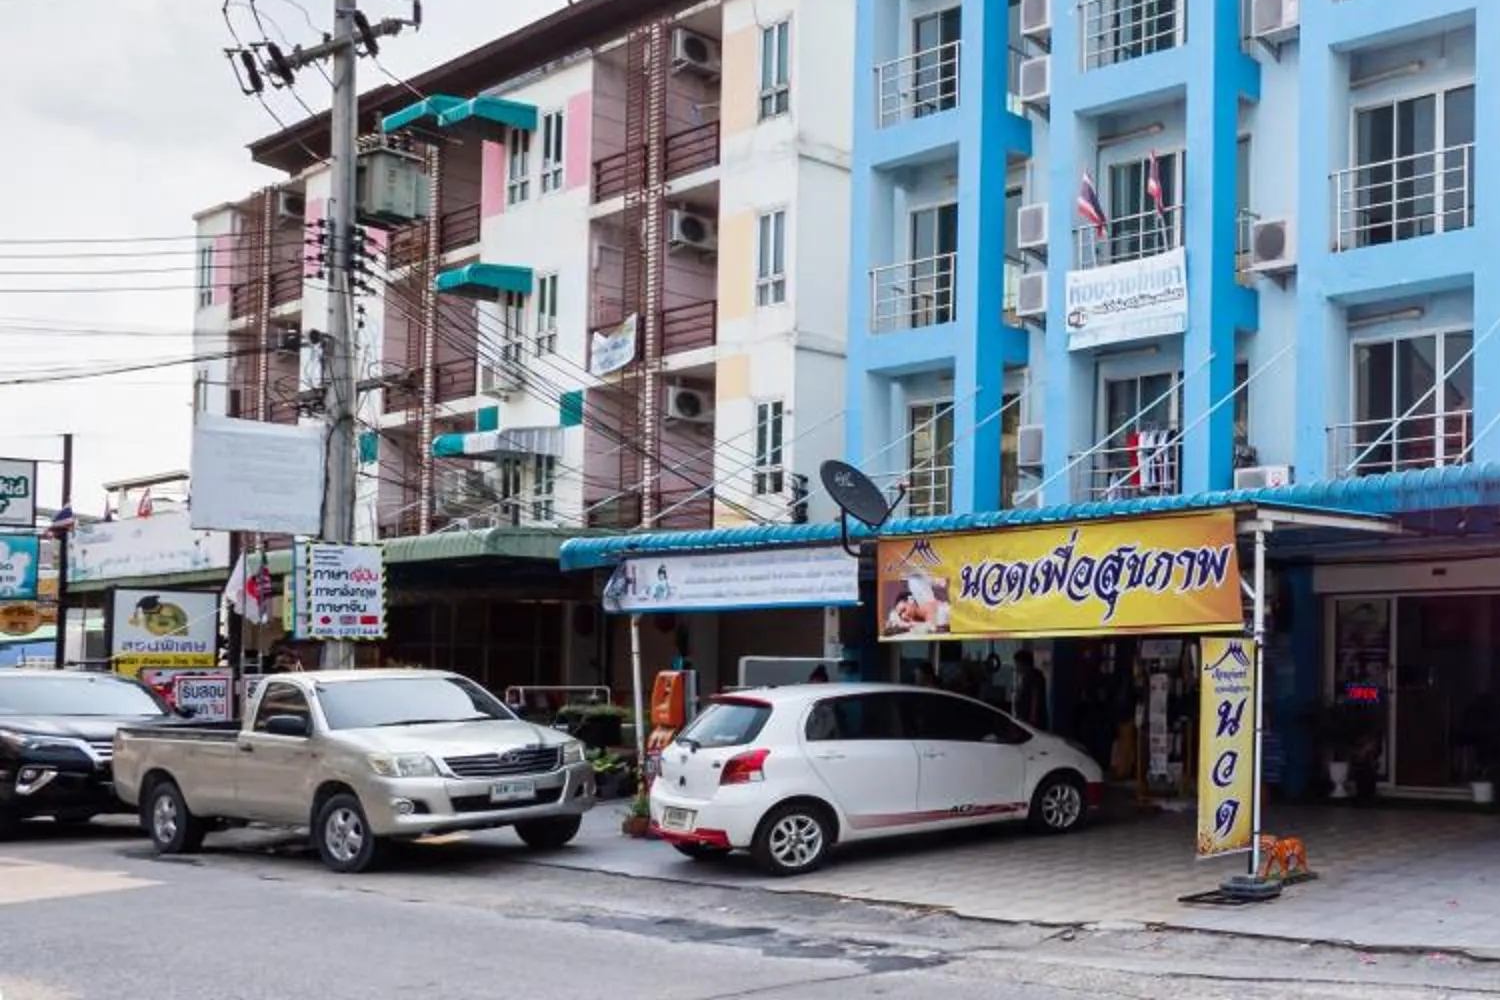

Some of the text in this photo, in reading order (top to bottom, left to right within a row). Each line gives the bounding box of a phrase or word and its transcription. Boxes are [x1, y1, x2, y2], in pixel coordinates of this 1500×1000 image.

[961, 529, 1232, 621] นวดเพื่อสุขภาพ
